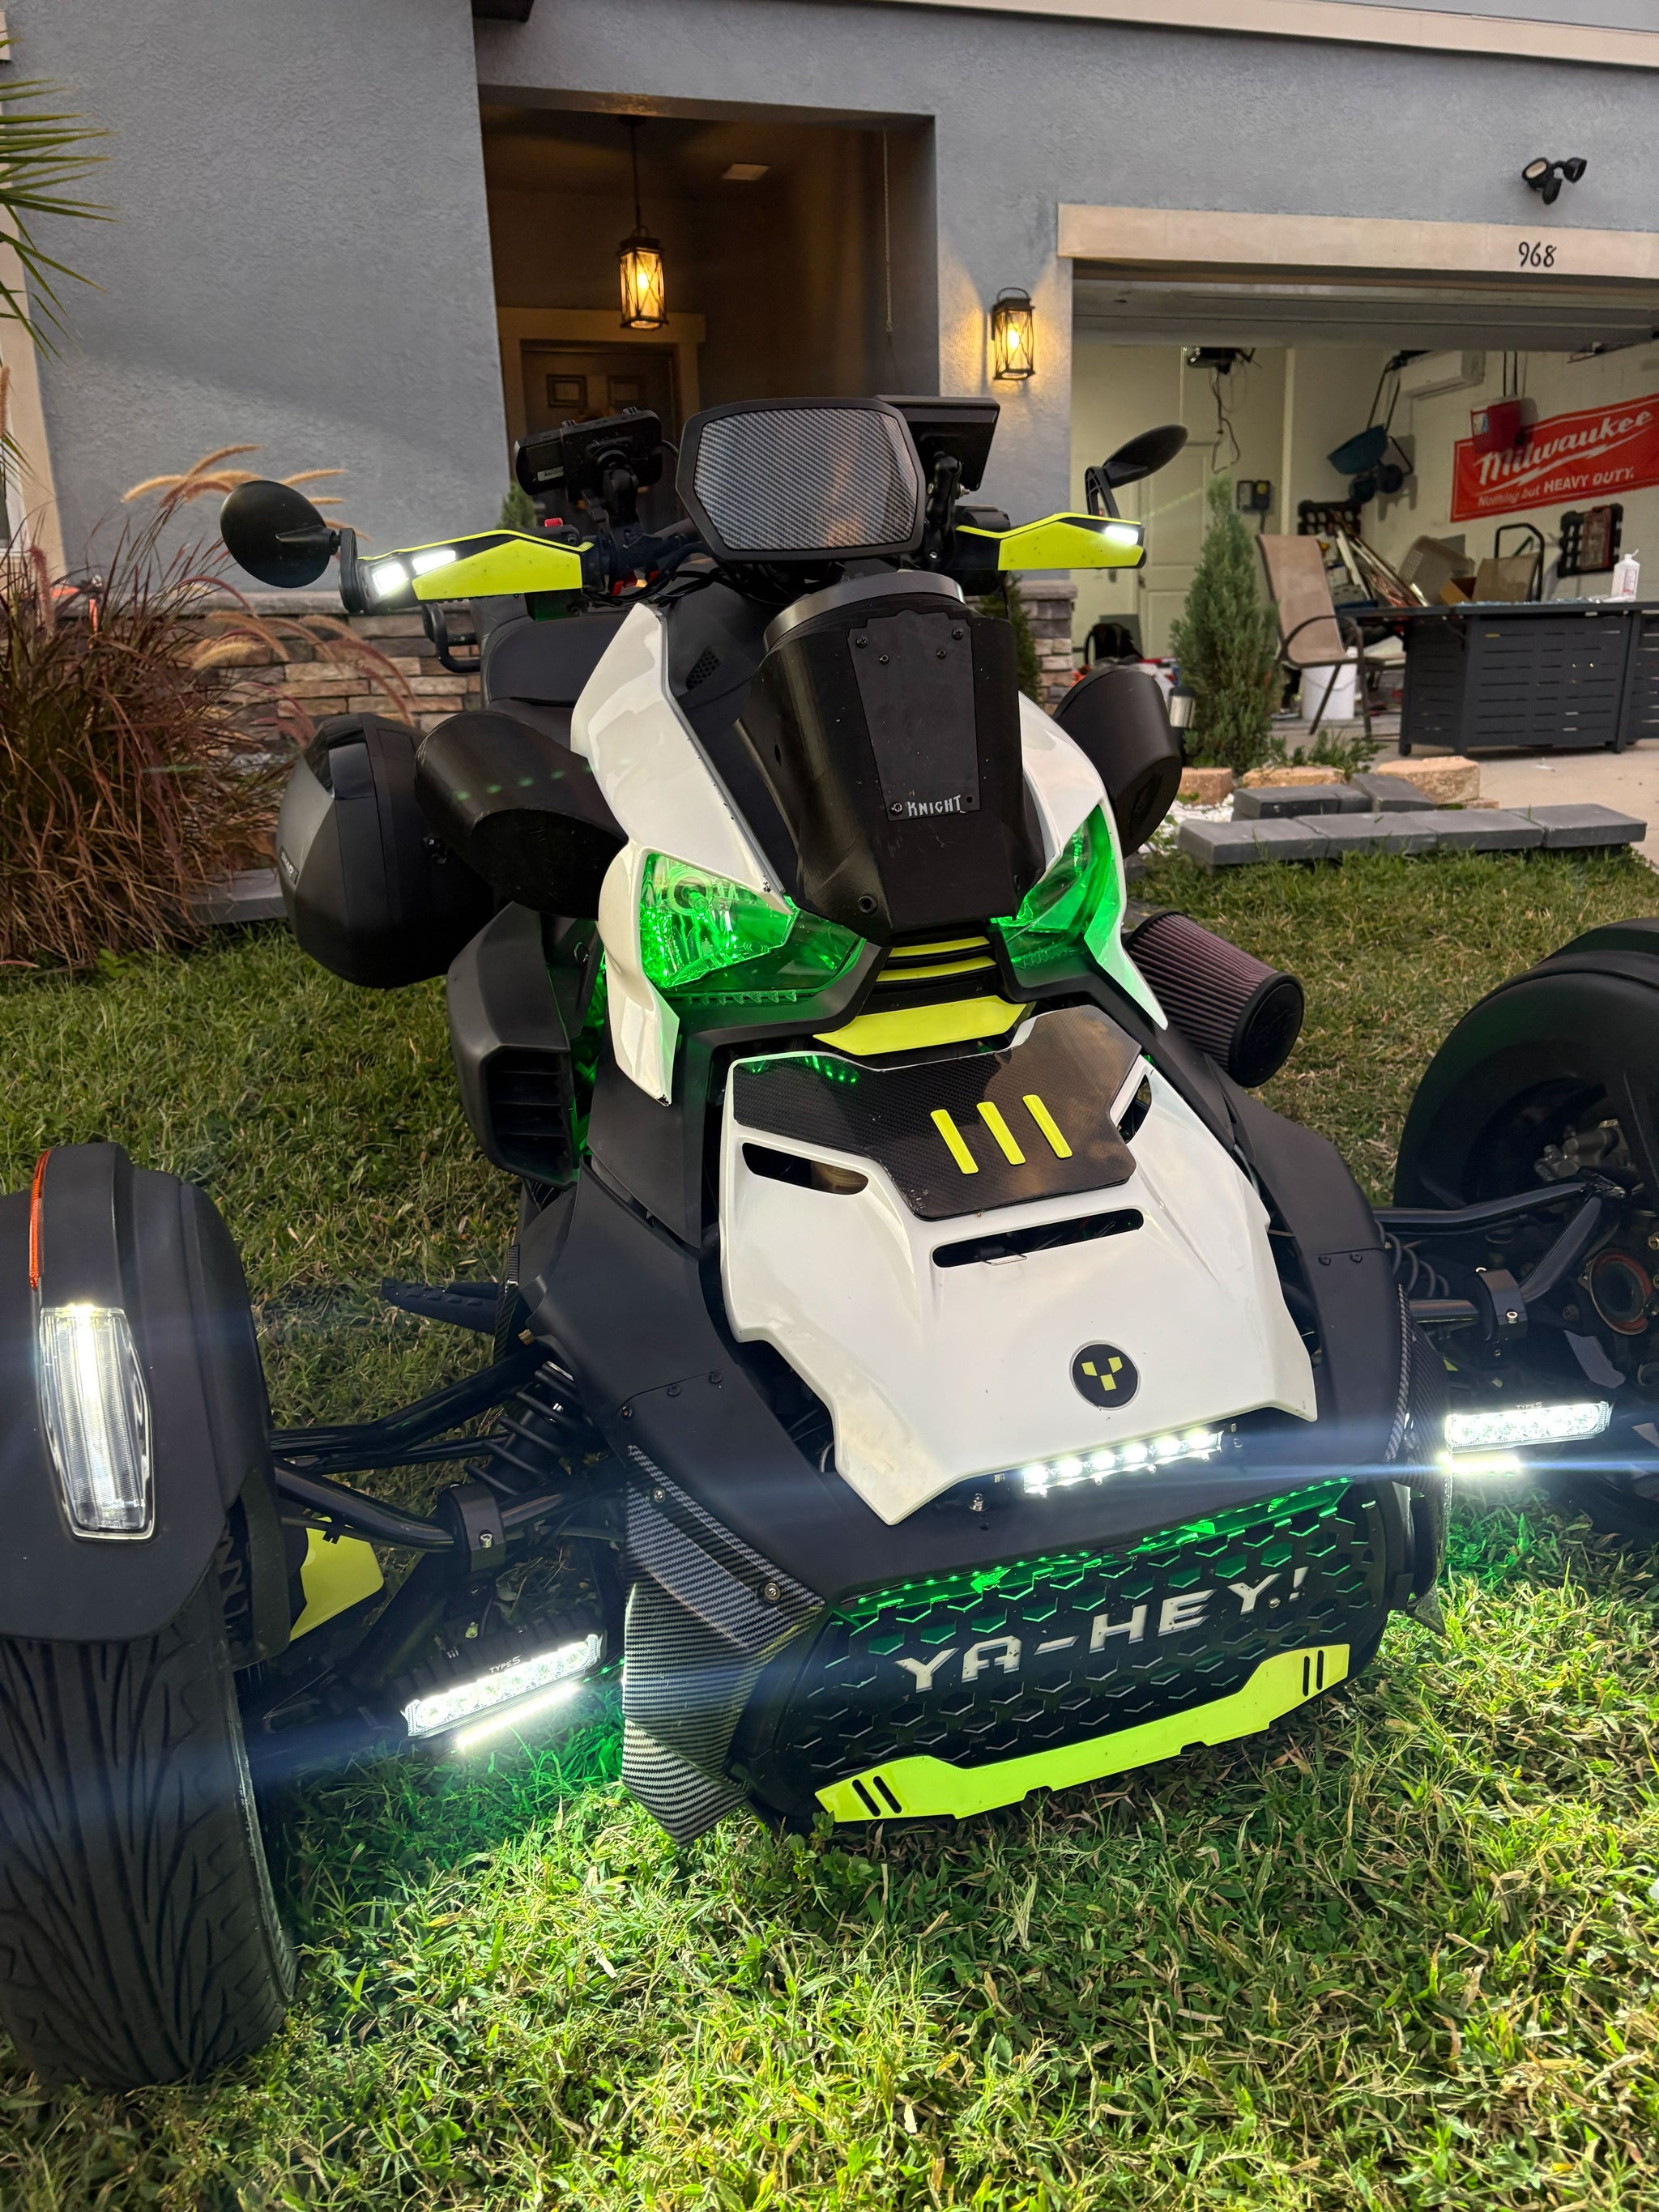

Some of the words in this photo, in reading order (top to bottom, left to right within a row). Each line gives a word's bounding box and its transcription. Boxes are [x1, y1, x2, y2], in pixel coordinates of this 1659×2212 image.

[1518, 241, 1557, 267] 968
[1473, 410, 1653, 486] Milwaukee
[1543, 473, 1590, 494] HEAVY
[906, 794, 962, 817] KNIGHT
